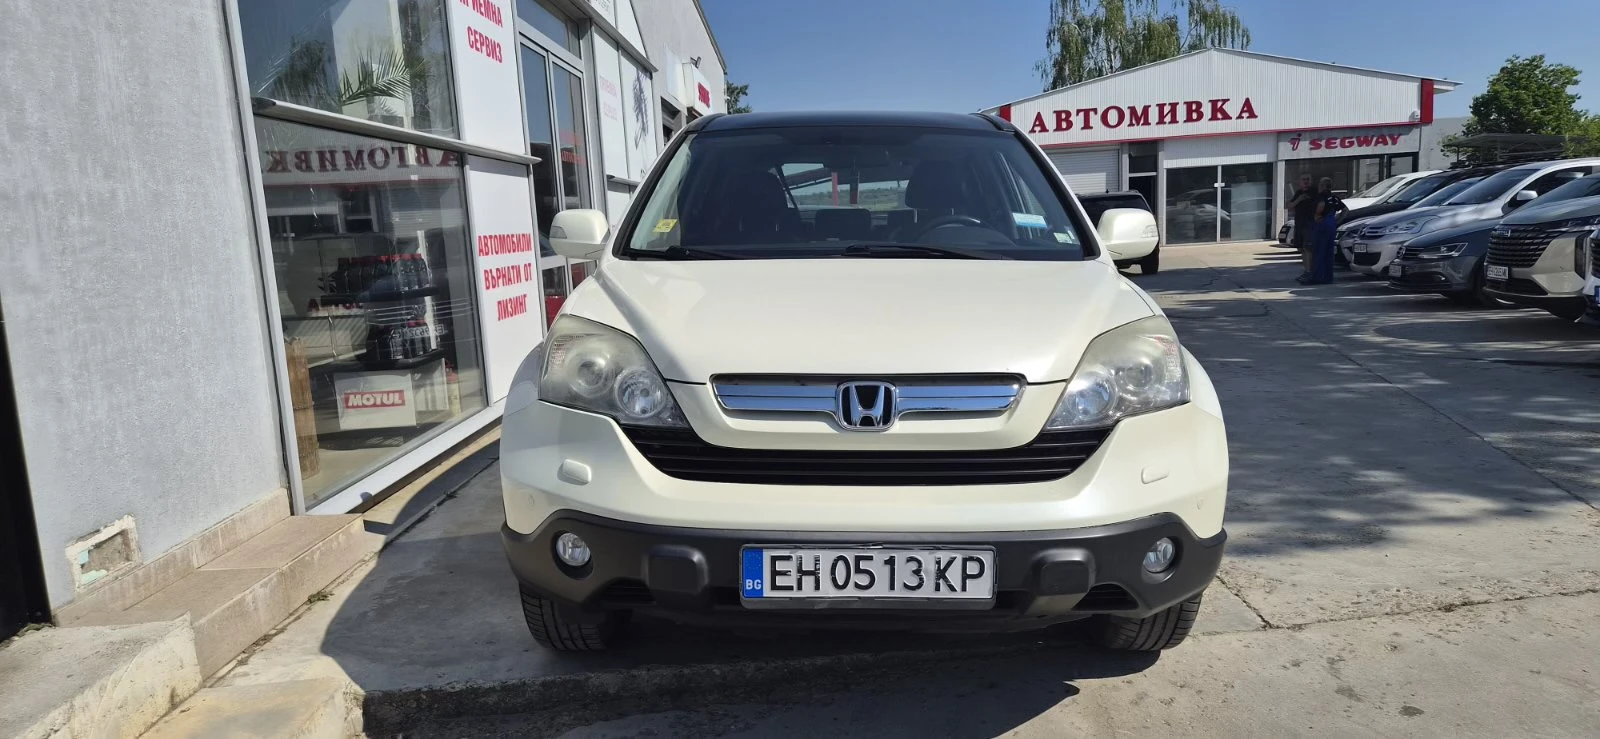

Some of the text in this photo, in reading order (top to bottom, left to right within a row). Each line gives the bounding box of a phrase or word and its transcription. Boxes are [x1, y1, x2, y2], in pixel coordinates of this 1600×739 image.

[460, 0, 503, 28] ИЕМНА
[467, 26, 503, 63] СЕРВИЗ
[1028, 97, 1258, 133] АВТОМИВКА
[1309, 133, 1402, 150] SEGWAY
[478, 233, 532, 256] АВТОМОБИЛИ
[484, 263, 532, 290] ВЪРНАТИ ОТ
[497, 294, 527, 321] ЛИЗИНГ
[347, 392, 402, 407] MOTUL
[745, 579, 762, 590] BG
[830, 554, 925, 592] 0513
